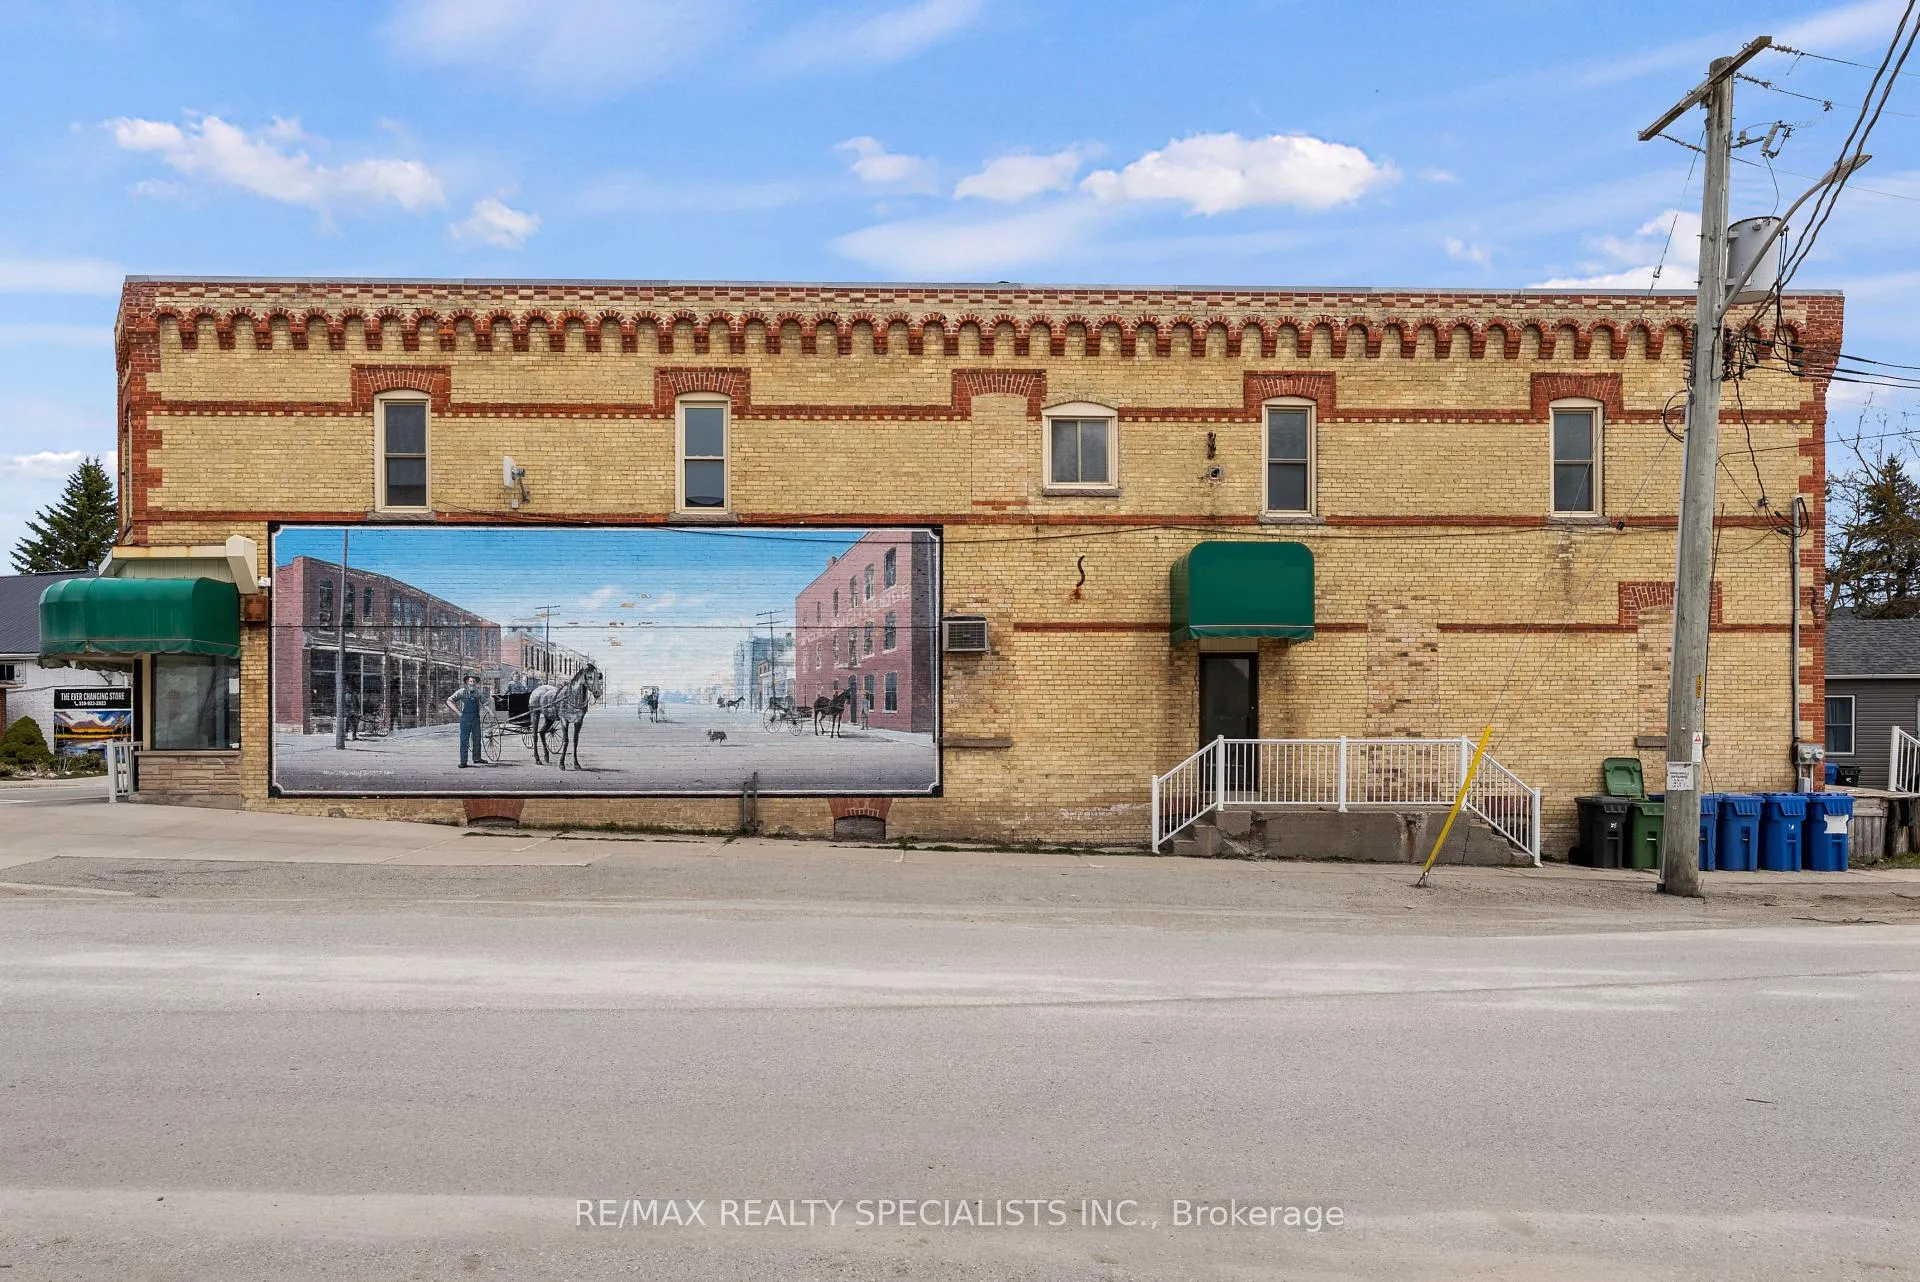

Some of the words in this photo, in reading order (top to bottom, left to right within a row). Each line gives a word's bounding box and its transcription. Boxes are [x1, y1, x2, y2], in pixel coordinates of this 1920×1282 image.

[61, 692, 70, 700] THE
[71, 692, 83, 700] EVER
[84, 692, 108, 700] CHANGING
[109, 692, 125, 700] STORE
